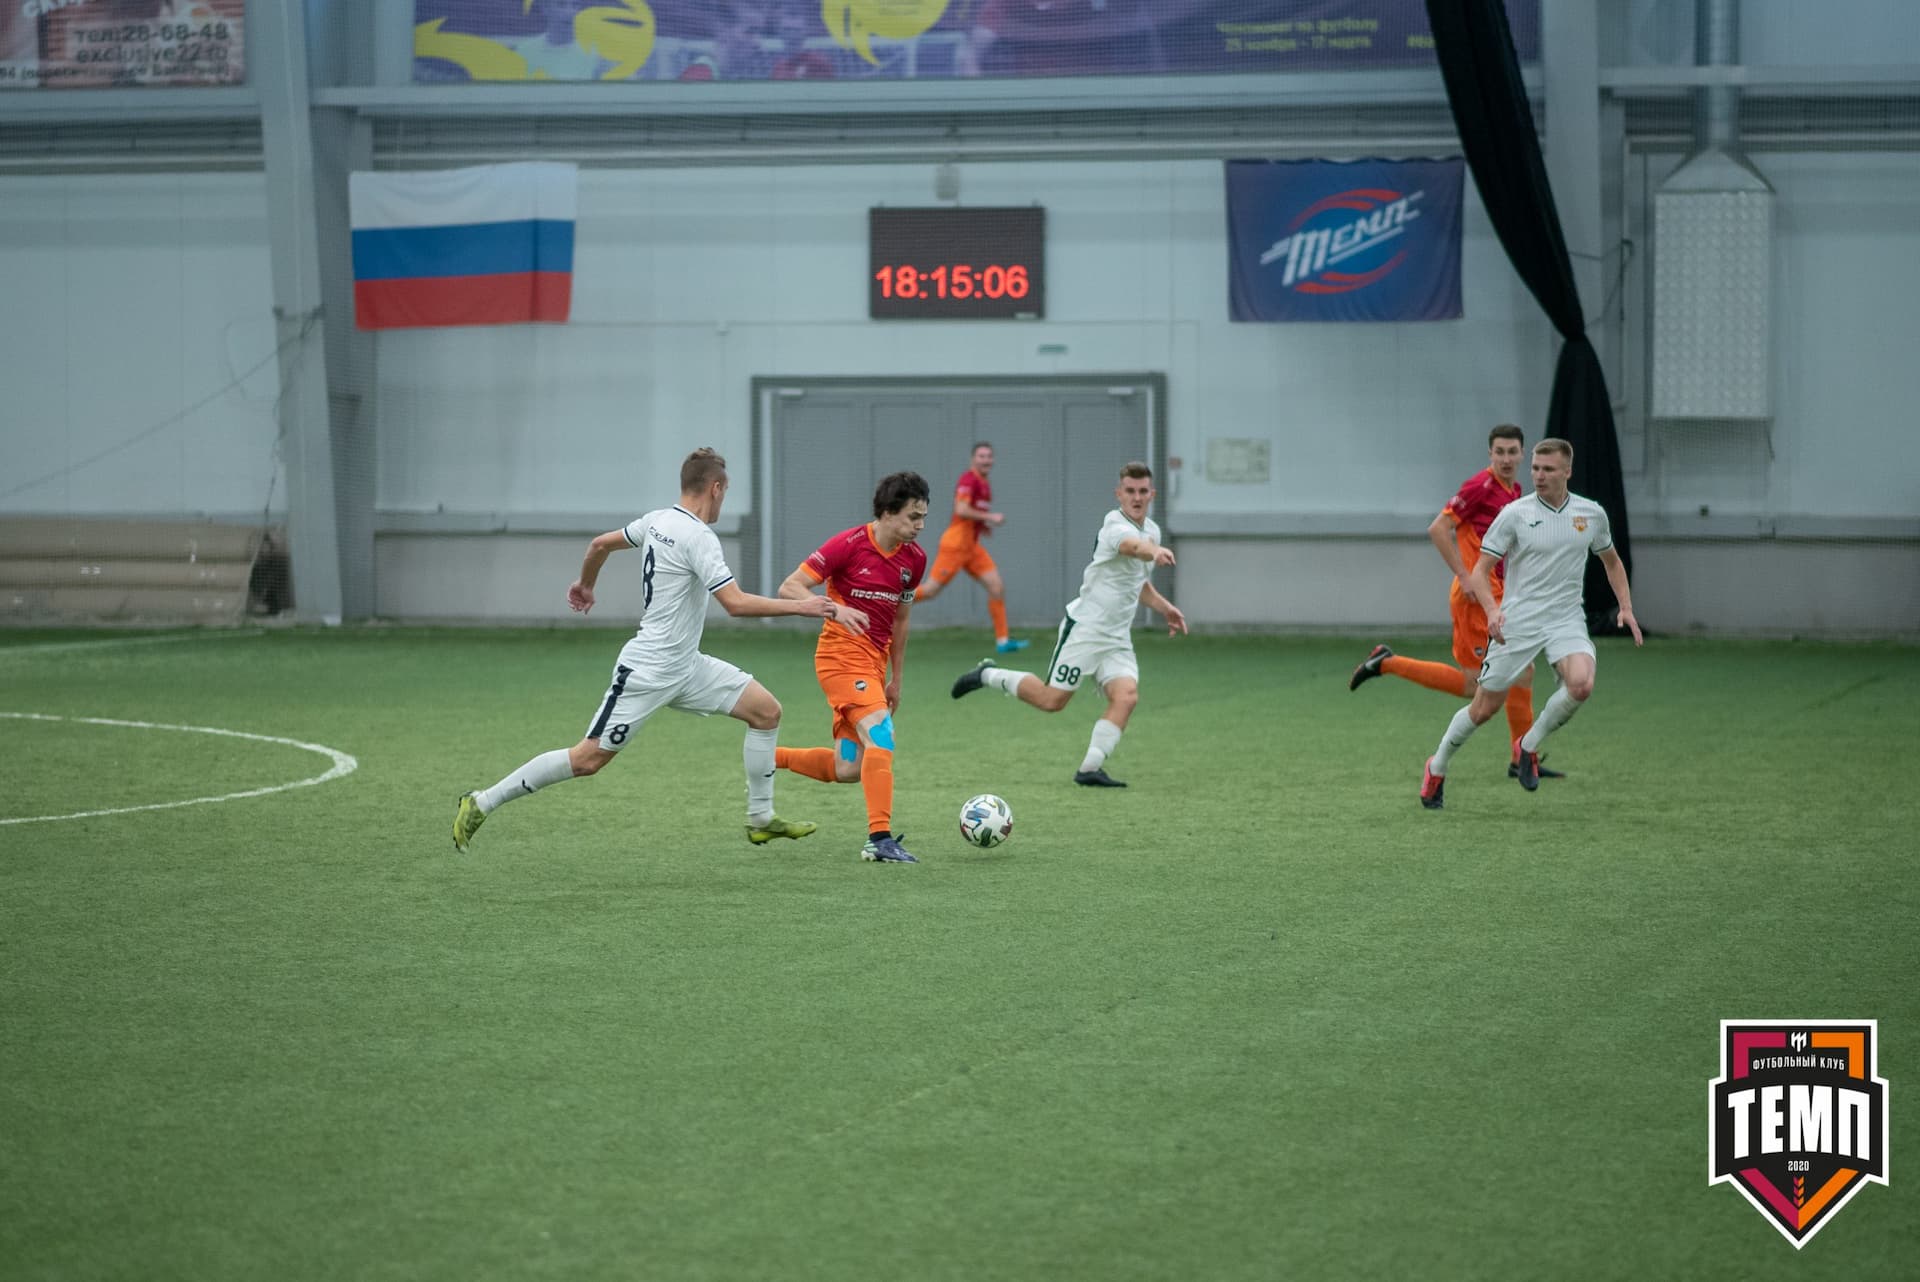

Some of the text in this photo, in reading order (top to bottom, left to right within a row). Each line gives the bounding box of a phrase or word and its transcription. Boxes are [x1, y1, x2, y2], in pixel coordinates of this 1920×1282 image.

[875, 264, 1030, 299] 18:15:06
[643, 544, 655, 609] 8
[1055, 664, 1081, 686] 98
[609, 723, 631, 746] 8
